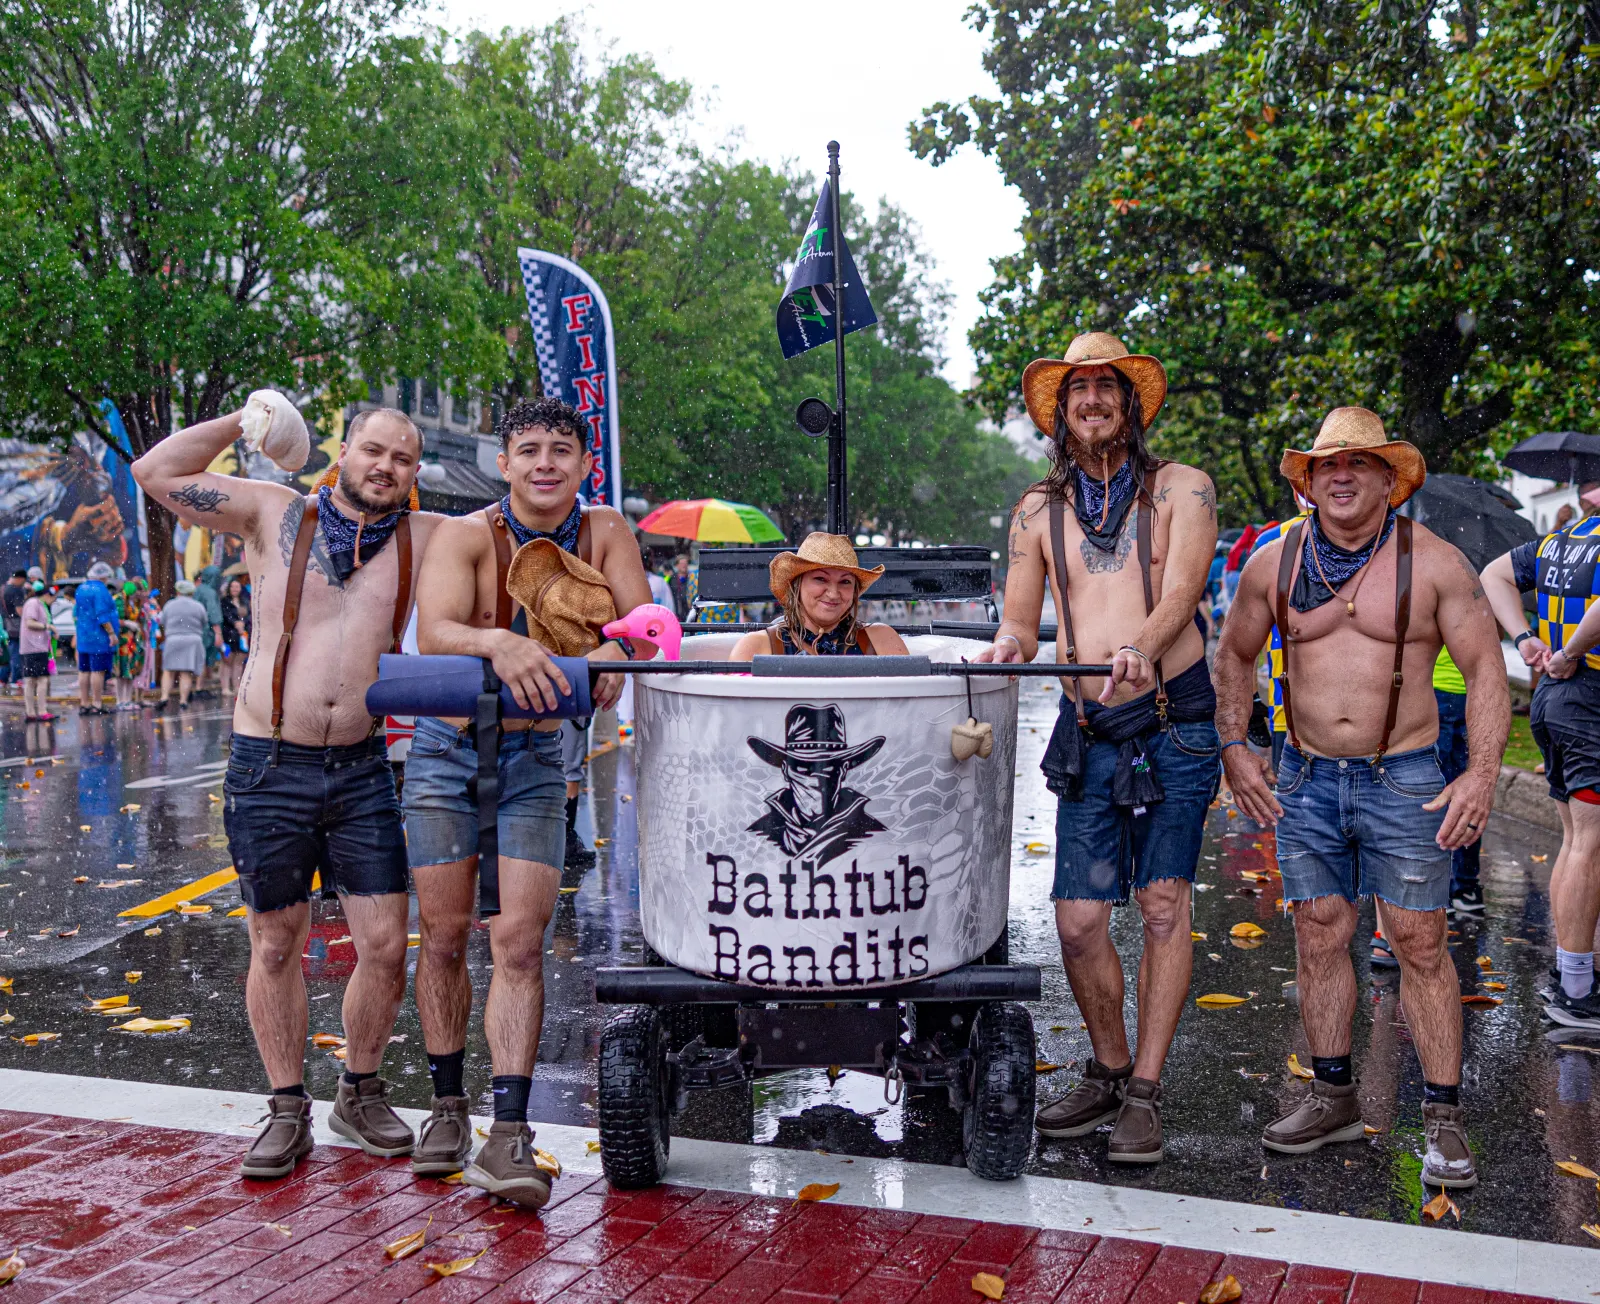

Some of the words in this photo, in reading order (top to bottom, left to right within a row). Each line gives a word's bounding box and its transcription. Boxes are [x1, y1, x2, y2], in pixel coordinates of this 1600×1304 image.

[561, 293, 606, 505] FINIS
[706, 852, 930, 920] Bathtub
[708, 923, 929, 987] Bandits
